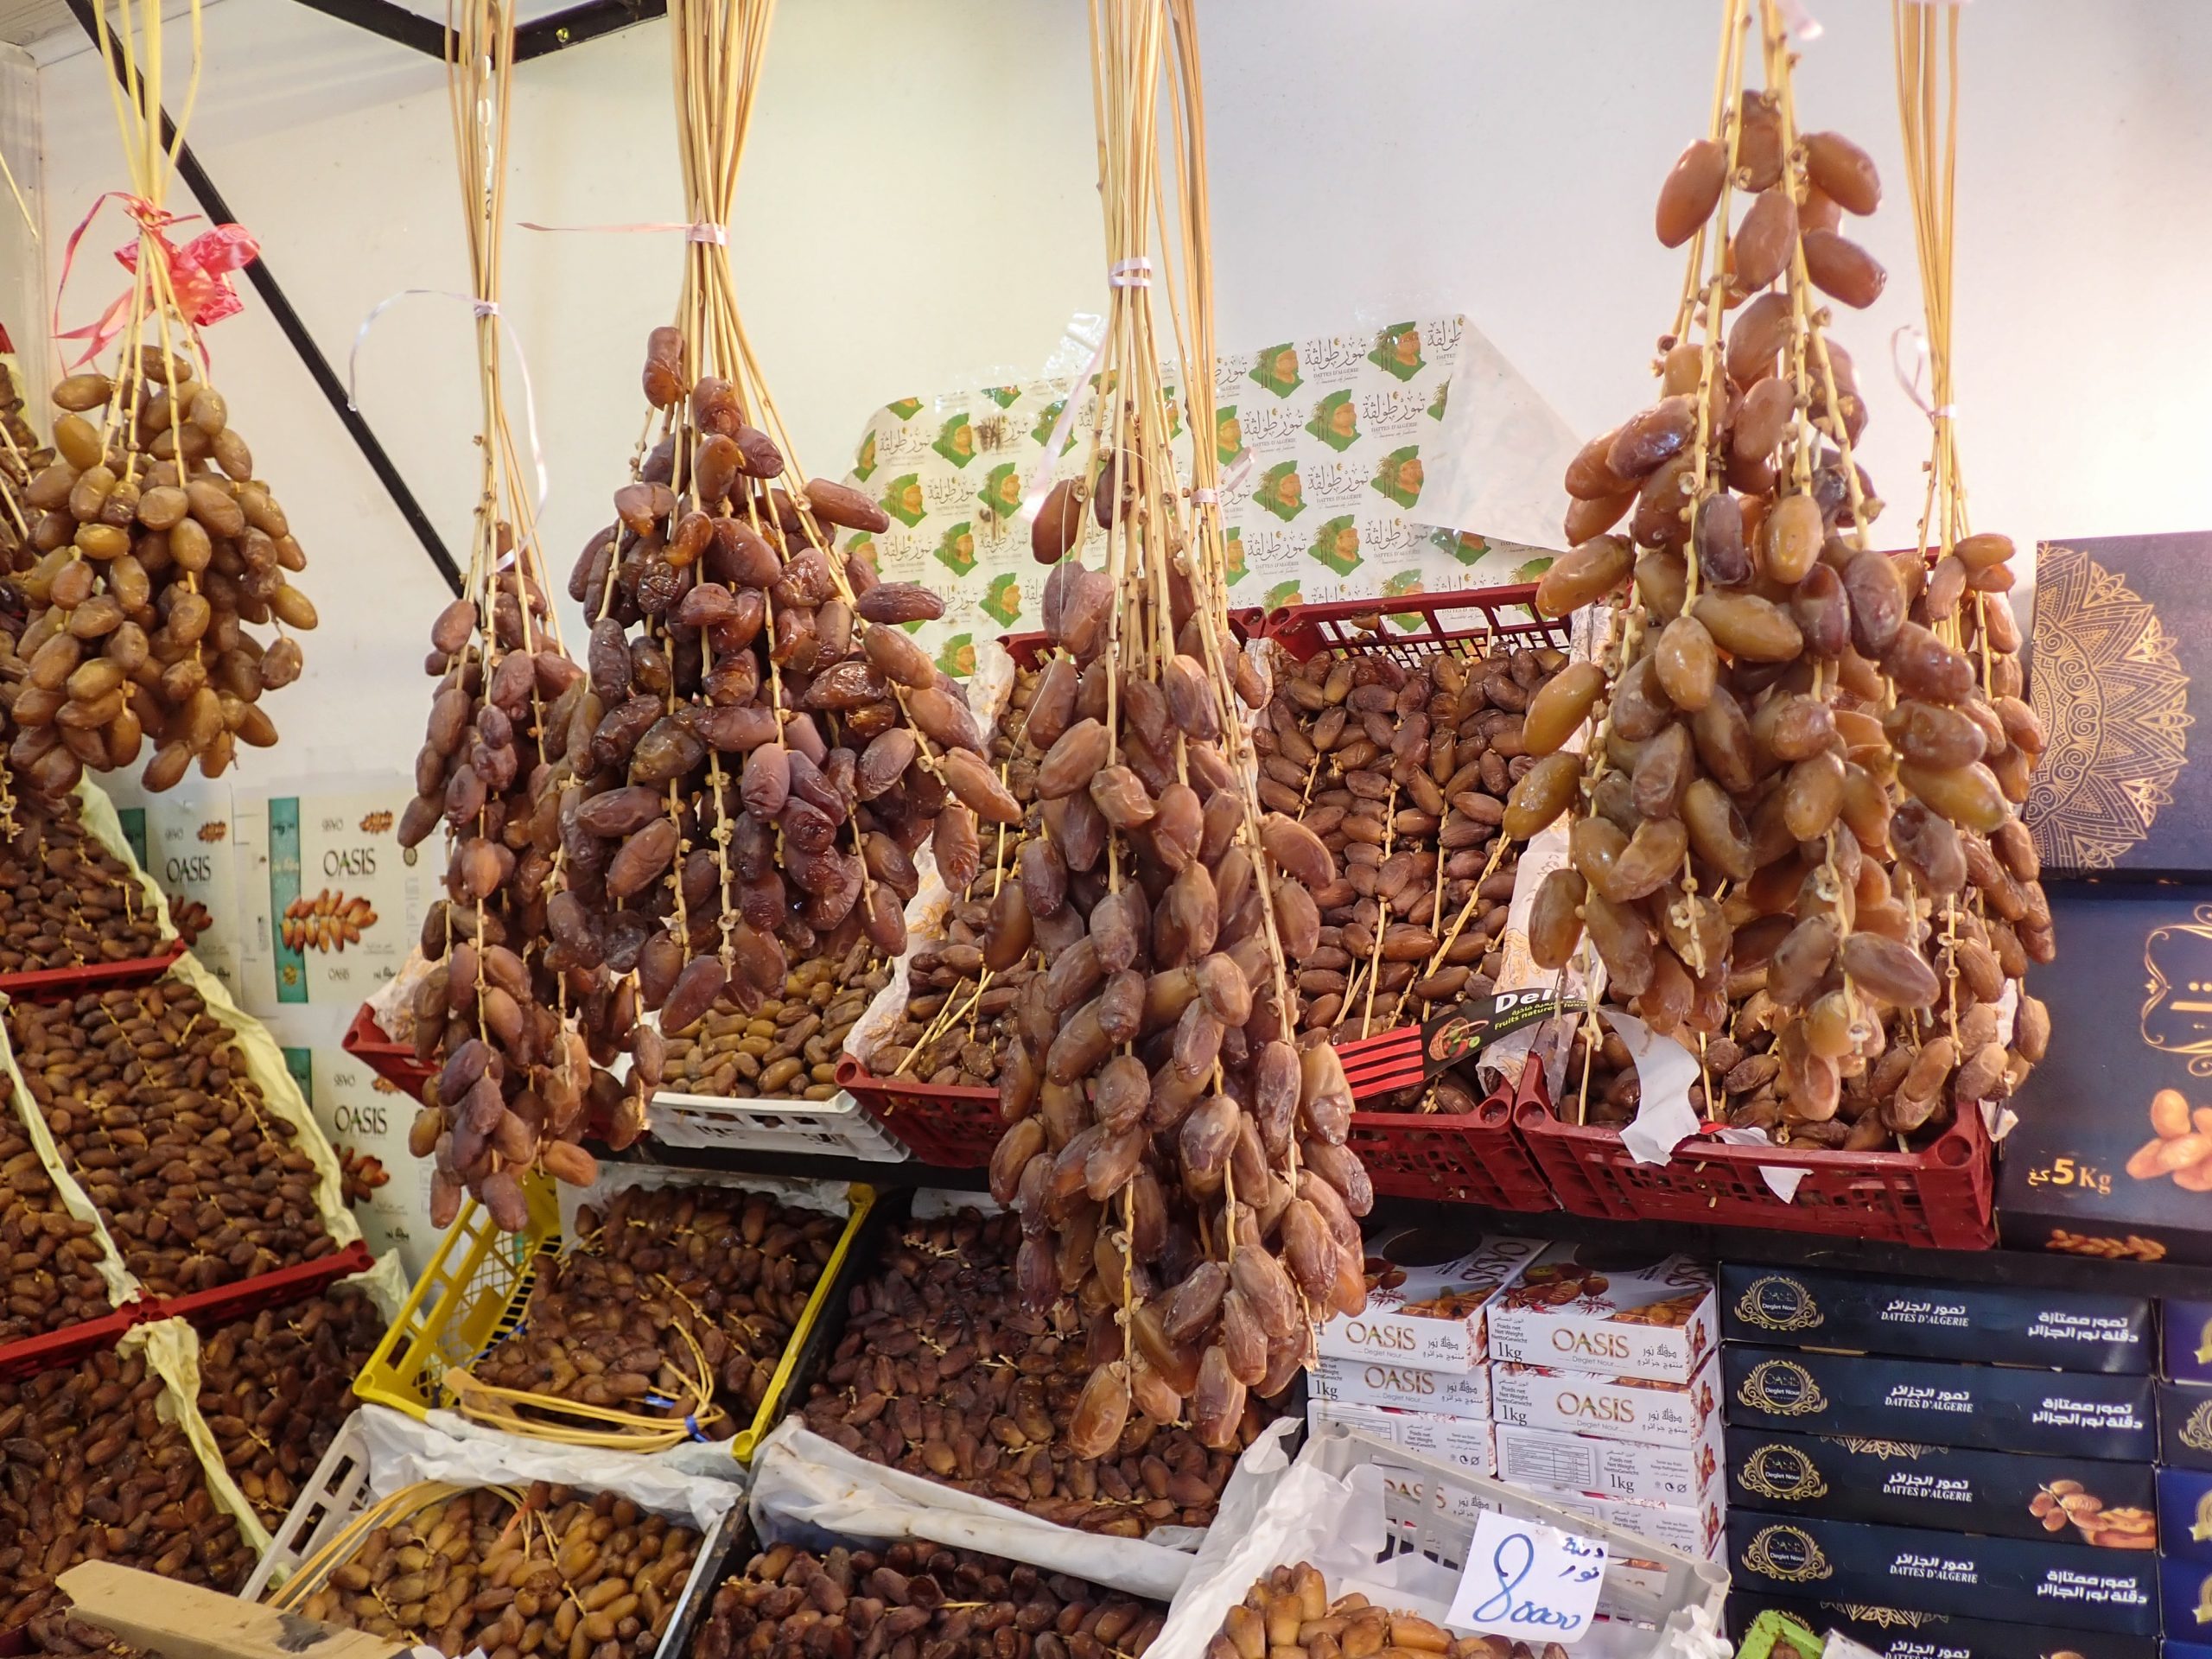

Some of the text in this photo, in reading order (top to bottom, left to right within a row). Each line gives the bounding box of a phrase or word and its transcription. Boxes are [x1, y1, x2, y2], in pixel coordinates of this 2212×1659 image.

[167, 855, 212, 883] OASIS
[323, 848, 377, 877] OASIS
[1495, 1016, 1520, 1030] Fruits
[334, 1105, 387, 1135] OASIS
[2051, 1158, 2075, 1185] 5
[2078, 1166, 2113, 1195] Kg
[1887, 1300, 1966, 1315] تمور الجزائر
[1881, 1311, 1969, 1326] DATTES D'ALGERIE
[2037, 1312, 2128, 1328] تمور ممتازة
[1345, 1321, 1416, 1351] OASIS
[1552, 1328, 1630, 1358] OASIS
[2027, 1325, 2139, 1343] دقلة نور الجزائر
[1363, 1348, 1385, 1357] Deglet
[1498, 1341, 1522, 1363] 1kg
[1572, 1356, 1615, 1367] Deglet Nour
[1364, 1365, 1435, 1395] OASIS
[1316, 1380, 1338, 1400] 1kg
[1382, 1392, 1421, 1403] Deglet Nour
[1891, 1384, 1970, 1402] تمور الجزائر
[1556, 1392, 1635, 1423] OASIS
[1885, 1395, 1973, 1413] DATTES D'ALGERIE
[2042, 1398, 2133, 1414] تمور ممتازة
[1503, 1404, 1527, 1426] 1kg
[2031, 1411, 2143, 1429] دقلة نور الجزائر
[1576, 1419, 1618, 1431] Deglet Nour
[1611, 1474, 1635, 1494] 1kg
[1888, 1471, 1969, 1490] تمور الجزائر
[1883, 1484, 1973, 1503] DATTES D'ALGERIE
[1895, 1553, 1974, 1571] تمور الجزائر
[1890, 1564, 1979, 1584] DATTES D'ALGERIE
[2046, 1570, 2137, 1589] تمور ممتازة
[2037, 1583, 2147, 1604] دقلة نور الجزائر
[1891, 1641, 1970, 1658] تمور الجزائر
